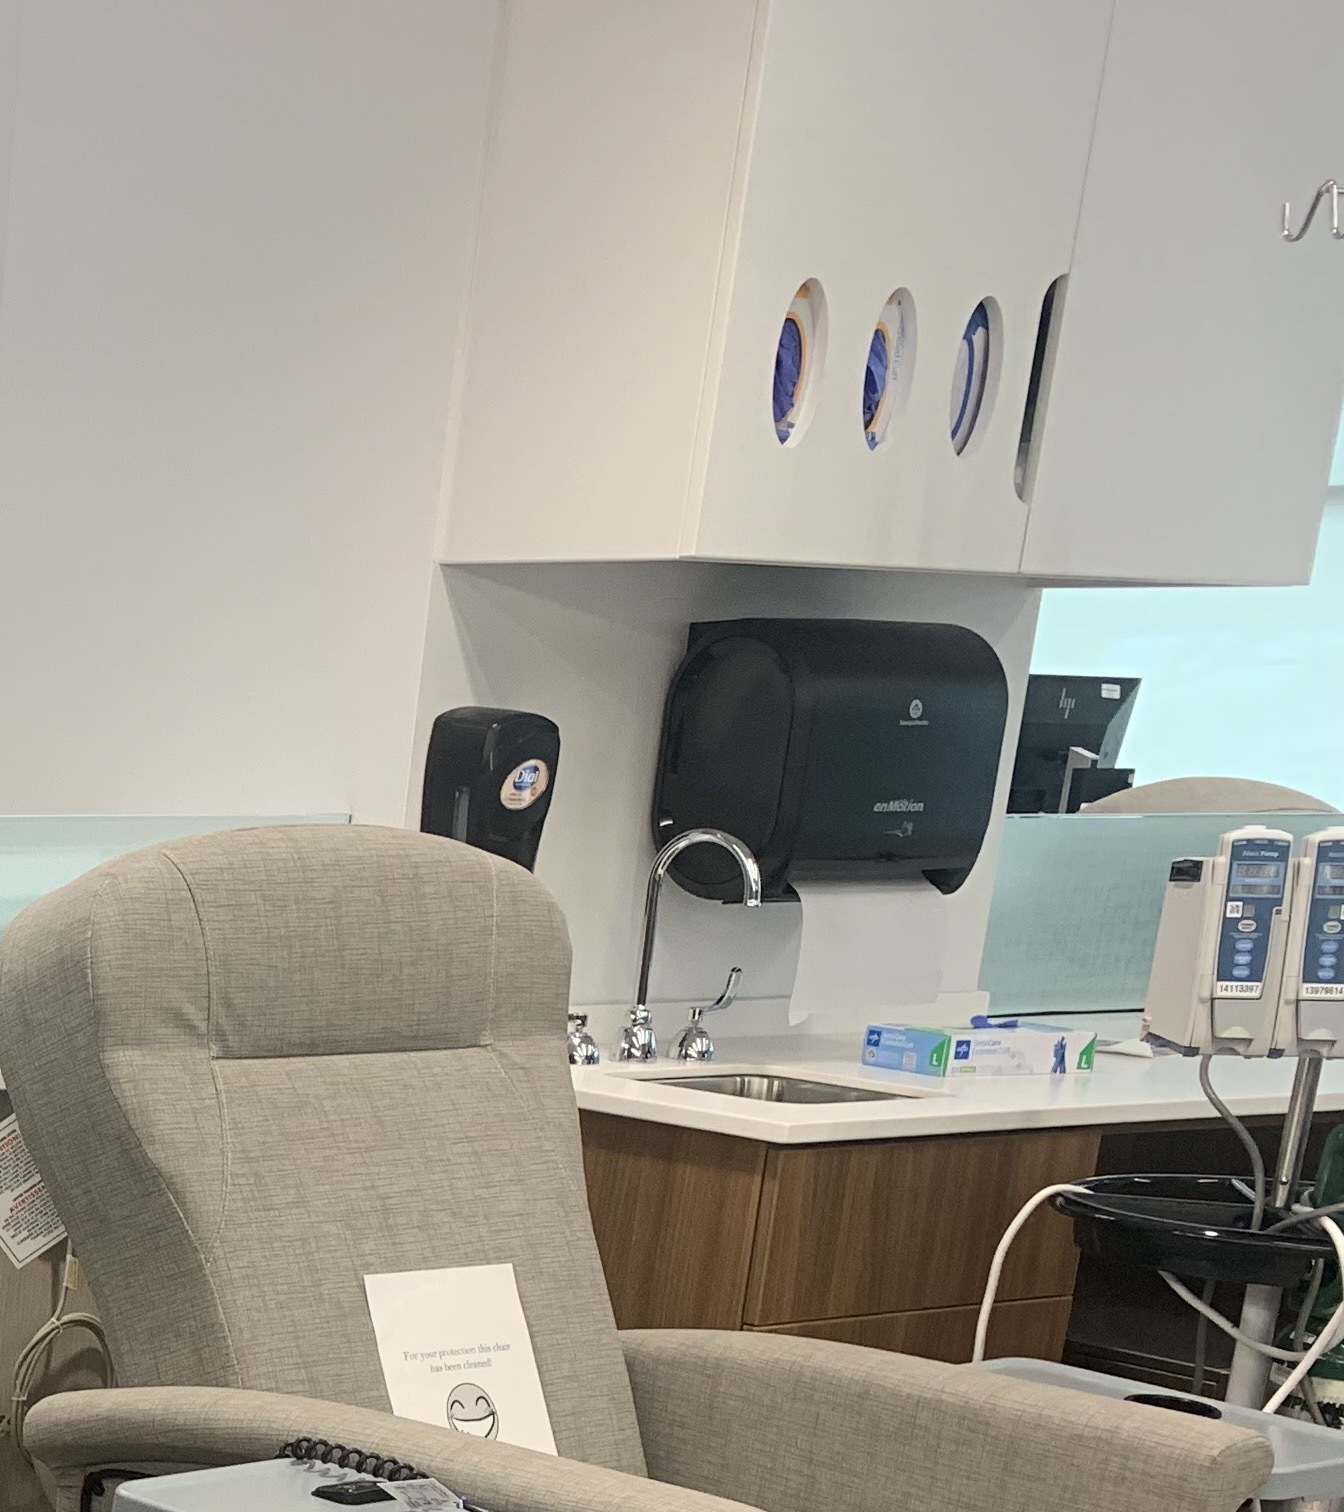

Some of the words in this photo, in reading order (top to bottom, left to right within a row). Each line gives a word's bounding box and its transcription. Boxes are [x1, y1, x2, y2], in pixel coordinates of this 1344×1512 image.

[515, 768, 539, 783] Dial
[1081, 1055, 1088, 1068] L
[403, 1351, 418, 1361] For
[420, 1351, 437, 1362] your
[438, 1347, 476, 1360] protection
[478, 1344, 491, 1353] this
[493, 1342, 510, 1351] chair
[430, 1364, 443, 1373] has
[444, 1363, 462, 1371] been
